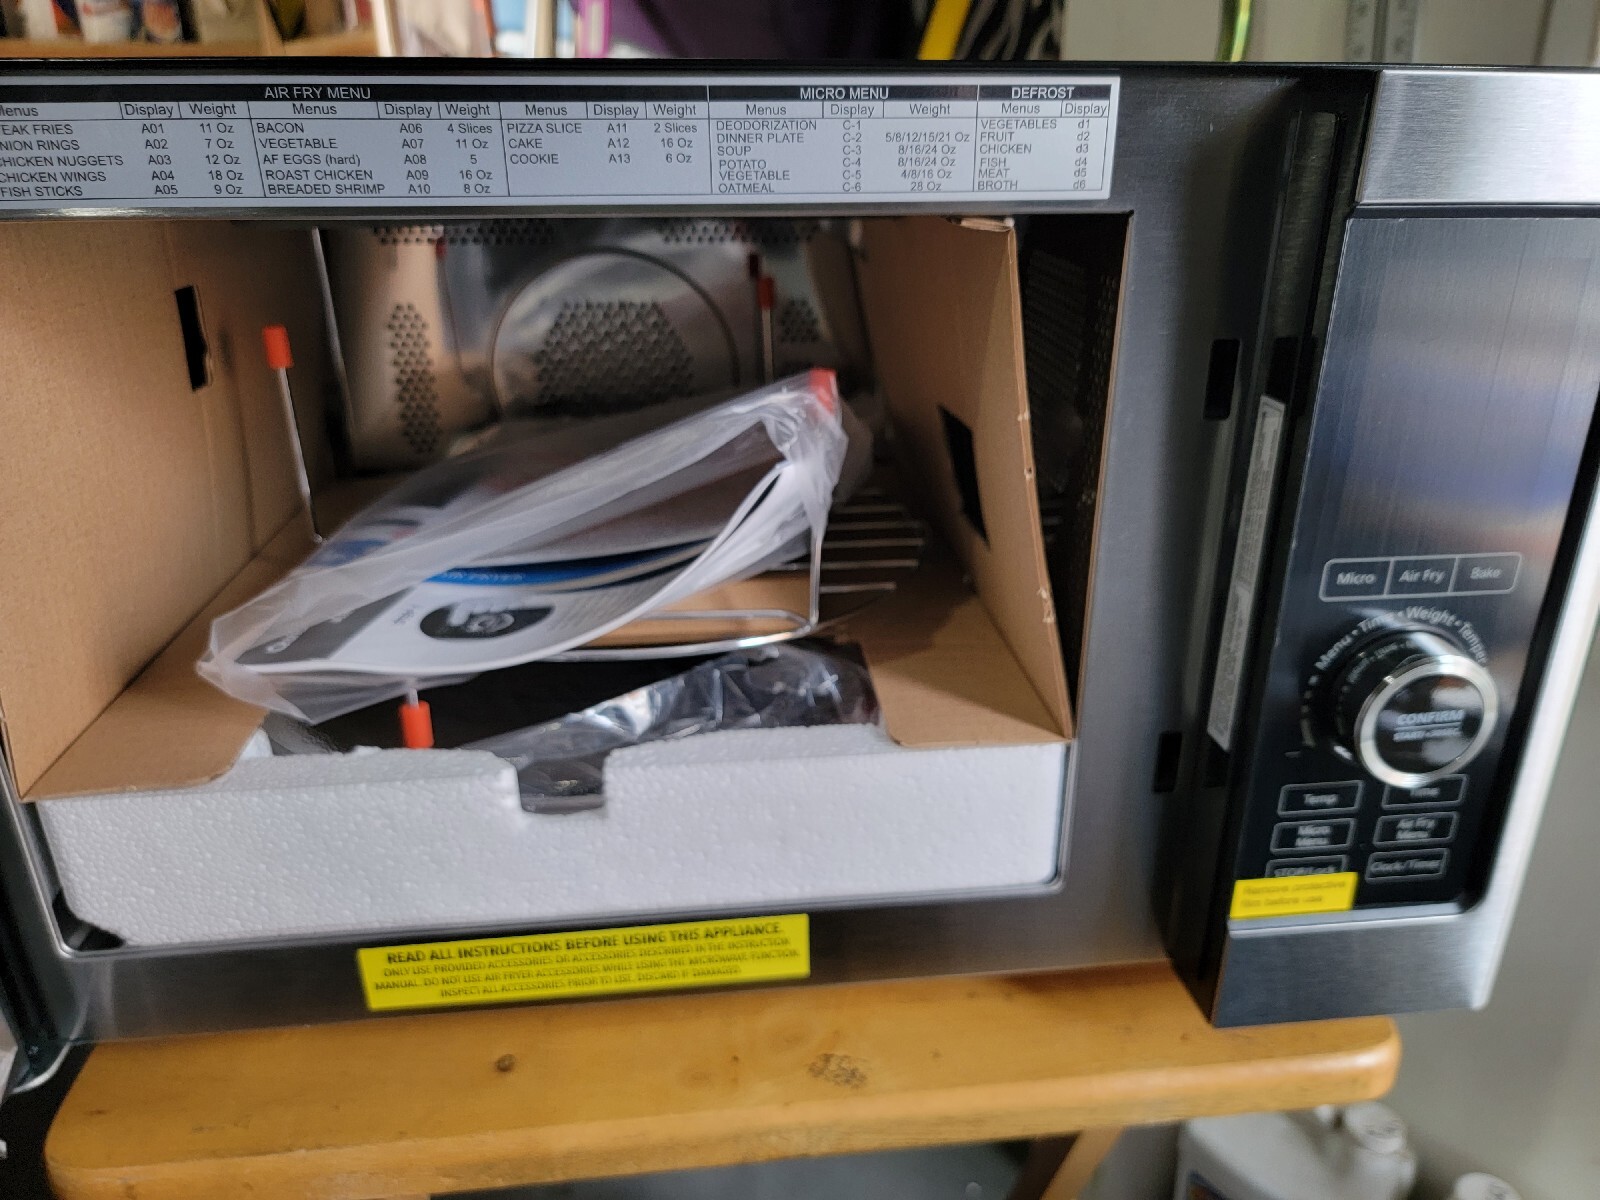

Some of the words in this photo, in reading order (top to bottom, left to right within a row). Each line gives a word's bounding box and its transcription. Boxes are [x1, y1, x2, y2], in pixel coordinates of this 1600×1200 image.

[264, 86, 290, 99] AIR
[294, 86, 322, 99] FRY
[327, 86, 371, 99] MENU
[800, 87, 846, 100] MICRO
[850, 87, 889, 100] MENU
[1011, 87, 1075, 99] DEFROST
[124, 103, 174, 117] Display
[189, 103, 237, 117] Weight
[292, 103, 338, 115] Menus
[384, 103, 432, 118] Display
[445, 103, 491, 117] Weight
[525, 104, 568, 116] Menus
[593, 104, 640, 118] Display
[653, 104, 697, 118] Weight
[746, 104, 787, 116] Menus
[830, 104, 874, 118] Display
[909, 103, 950, 117] Weight
[1001, 103, 1040, 114] Menus
[1065, 103, 1108, 117] Display
[0, 124, 30, 136] EAK
[33, 123, 74, 135] FRIES
[141, 123, 164, 134] A01
[200, 123, 213, 134] 11
[217, 122, 235, 134] Oz
[256, 122, 304, 134] BACON
[400, 123, 423, 134] A06
[447, 123, 454, 134] 4
[457, 122, 493, 134] Slices
[507, 123, 542, 134] PIZZA
[546, 123, 582, 134] SLICE
[607, 123, 628, 134] A11
[653, 123, 661, 134] 2
[665, 123, 698, 134] Slices
[716, 120, 817, 131] DEODORIZATION
[842, 121, 861, 131] C-1
[981, 119, 1057, 129] VEGETABLES
[1077, 119, 1090, 129] d1
[717, 133, 763, 143] DINNER
[767, 133, 804, 143] PLATE
[842, 133, 862, 143] C-2
[886, 132, 950, 143] 5/8/12/15/21
[954, 132, 970, 143] Oz
[980, 132, 1015, 142] FRUIT
[1077, 131, 1090, 141] d2
[38, 139, 80, 151] RINGS
[145, 139, 169, 150] A02
[204, 138, 212, 149] 7
[216, 138, 235, 149] Oz
[259, 138, 337, 149] VEGETABLE
[401, 138, 424, 149] A07
[456, 139, 468, 149] 11
[472, 139, 489, 149] Oz
[509, 138, 543, 149] CAKE
[607, 138, 630, 149] A12
[661, 138, 674, 149] 16
[677, 138, 693, 149] Oz
[979, 144, 1032, 154] CHICKEN
[1075, 143, 1089, 153] d3
[717, 146, 752, 157] SOUP
[842, 145, 862, 155] C-3
[898, 144, 937, 155] 8/16/24
[941, 144, 956, 155] Oz
[0, 156, 54, 167] HICKEN
[58, 155, 124, 167] NUGGETS
[148, 154, 172, 166] A03
[206, 154, 220, 165] 12
[223, 154, 241, 166] Oz
[263, 154, 278, 165] AF
[283, 154, 322, 165] EGGS
[325, 154, 361, 166] (hard)
[404, 154, 427, 165] A08
[470, 154, 477, 165] 5
[510, 154, 560, 165] COOKIE
[608, 154, 631, 165] A13
[666, 154, 673, 164] 6
[676, 154, 692, 164] Oz
[719, 159, 767, 170] POTATO
[842, 158, 862, 168] C-4
[897, 157, 937, 167] 8/16/24
[940, 157, 956, 167] Oz
[980, 157, 1006, 167] FISH
[1074, 157, 1087, 167] d4
[0, 172, 57, 183] CHICKEN
[61, 171, 107, 182] WINGS
[151, 170, 175, 181] A04
[208, 170, 223, 181] 18
[226, 170, 244, 182] Oz
[265, 169, 310, 181] ROAST
[314, 169, 373, 181] CHICKEN
[406, 169, 429, 181] A09
[459, 170, 473, 180] 16
[476, 170, 493, 180] Oz
[719, 170, 791, 181] VEGETABLE
[842, 170, 862, 180] C-5
[901, 169, 934, 179] 4/8/16
[937, 170, 952, 180] Oz
[978, 169, 1010, 178] MEAT
[1074, 168, 1087, 178] d5
[154, 185, 179, 195] A05
[214, 184, 222, 195] 9
[225, 184, 244, 195] Oz
[268, 184, 331, 195] BREADED
[335, 184, 386, 195] SHRIMP
[408, 184, 431, 195] A10
[463, 184, 471, 194] 8
[474, 184, 491, 194] Oz
[718, 183, 775, 193] OATMEAL
[842, 182, 862, 192] C-6
[910, 181, 924, 191] 28
[927, 182, 942, 191] Oz
[978, 180, 1018, 190] BROTH
[1073, 180, 1086, 190] d6
[1, 187, 31, 197] FISH
[35, 186, 83, 196] STICKS
[1336, 572, 1376, 585] Micro
[1399, 570, 1420, 583] Air
[1422, 569, 1445, 585] Fry
[1470, 567, 1502, 580] Bake
[1406, 606, 1457, 627] Weight
[1398, 710, 1464, 726] CONFIRM
[387, 951, 426, 964] READ
[430, 949, 456, 960] ALL
[458, 941, 562, 958] INSTRUCTIONS
[566, 935, 619, 949] BEFORE
[623, 932, 666, 945] USING
[669, 928, 699, 941] THIS
[384, 968, 410, 977] ONLY
[412, 966, 432, 974] USE
[434, 962, 486, 973] PROVIDED
